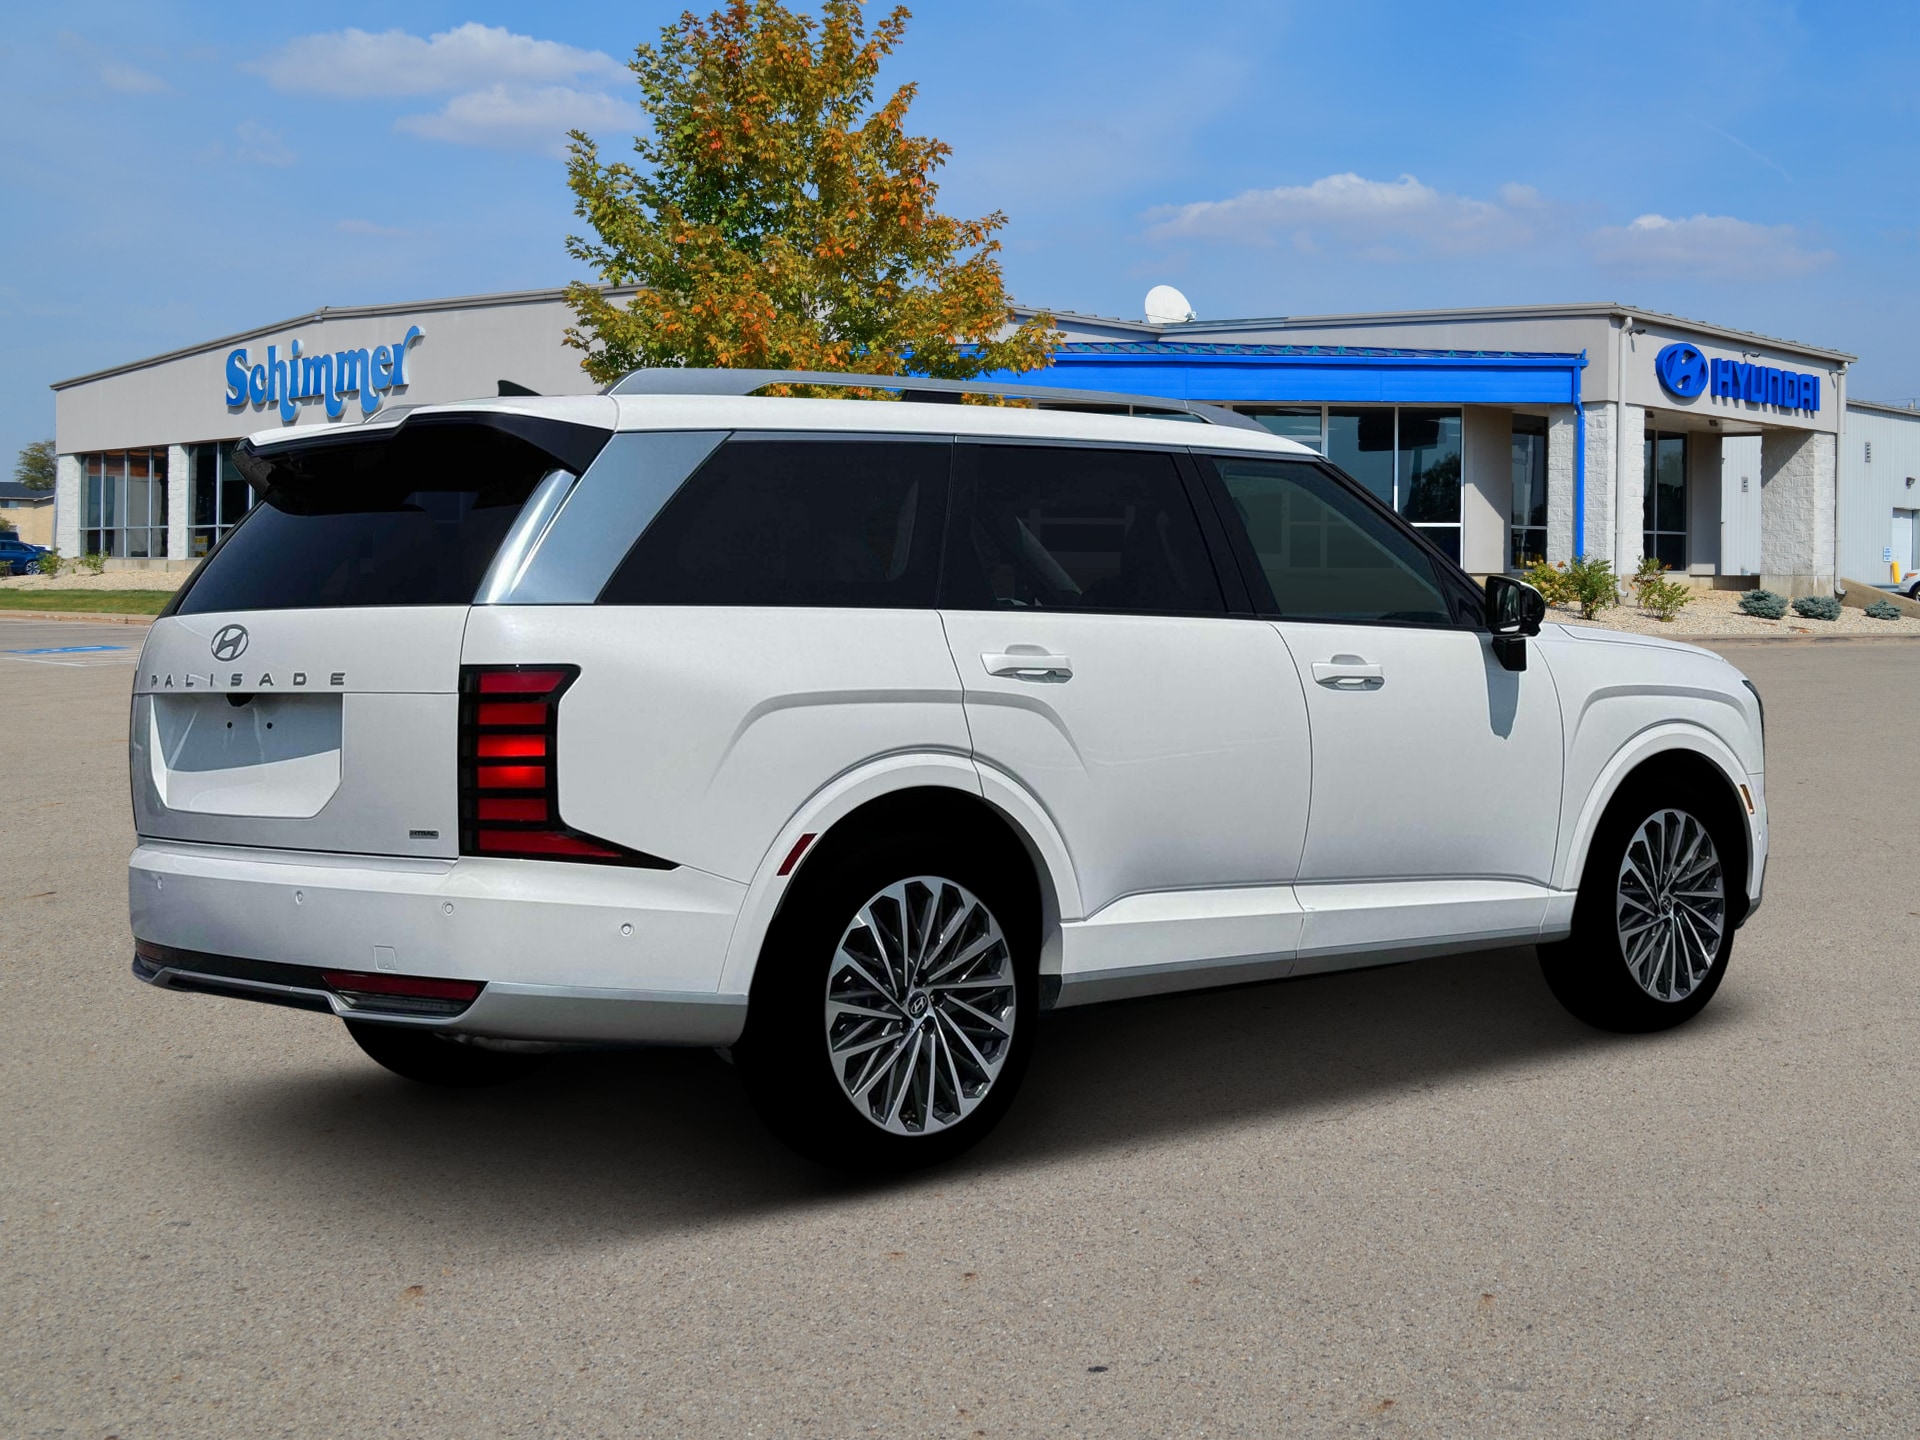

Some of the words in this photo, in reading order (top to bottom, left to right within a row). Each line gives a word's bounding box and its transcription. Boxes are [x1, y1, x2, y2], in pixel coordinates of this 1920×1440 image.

[225, 325, 425, 421] Schimmer
[1710, 358, 1820, 411] HYUNDAI
[150, 672, 346, 688] PALISADE
